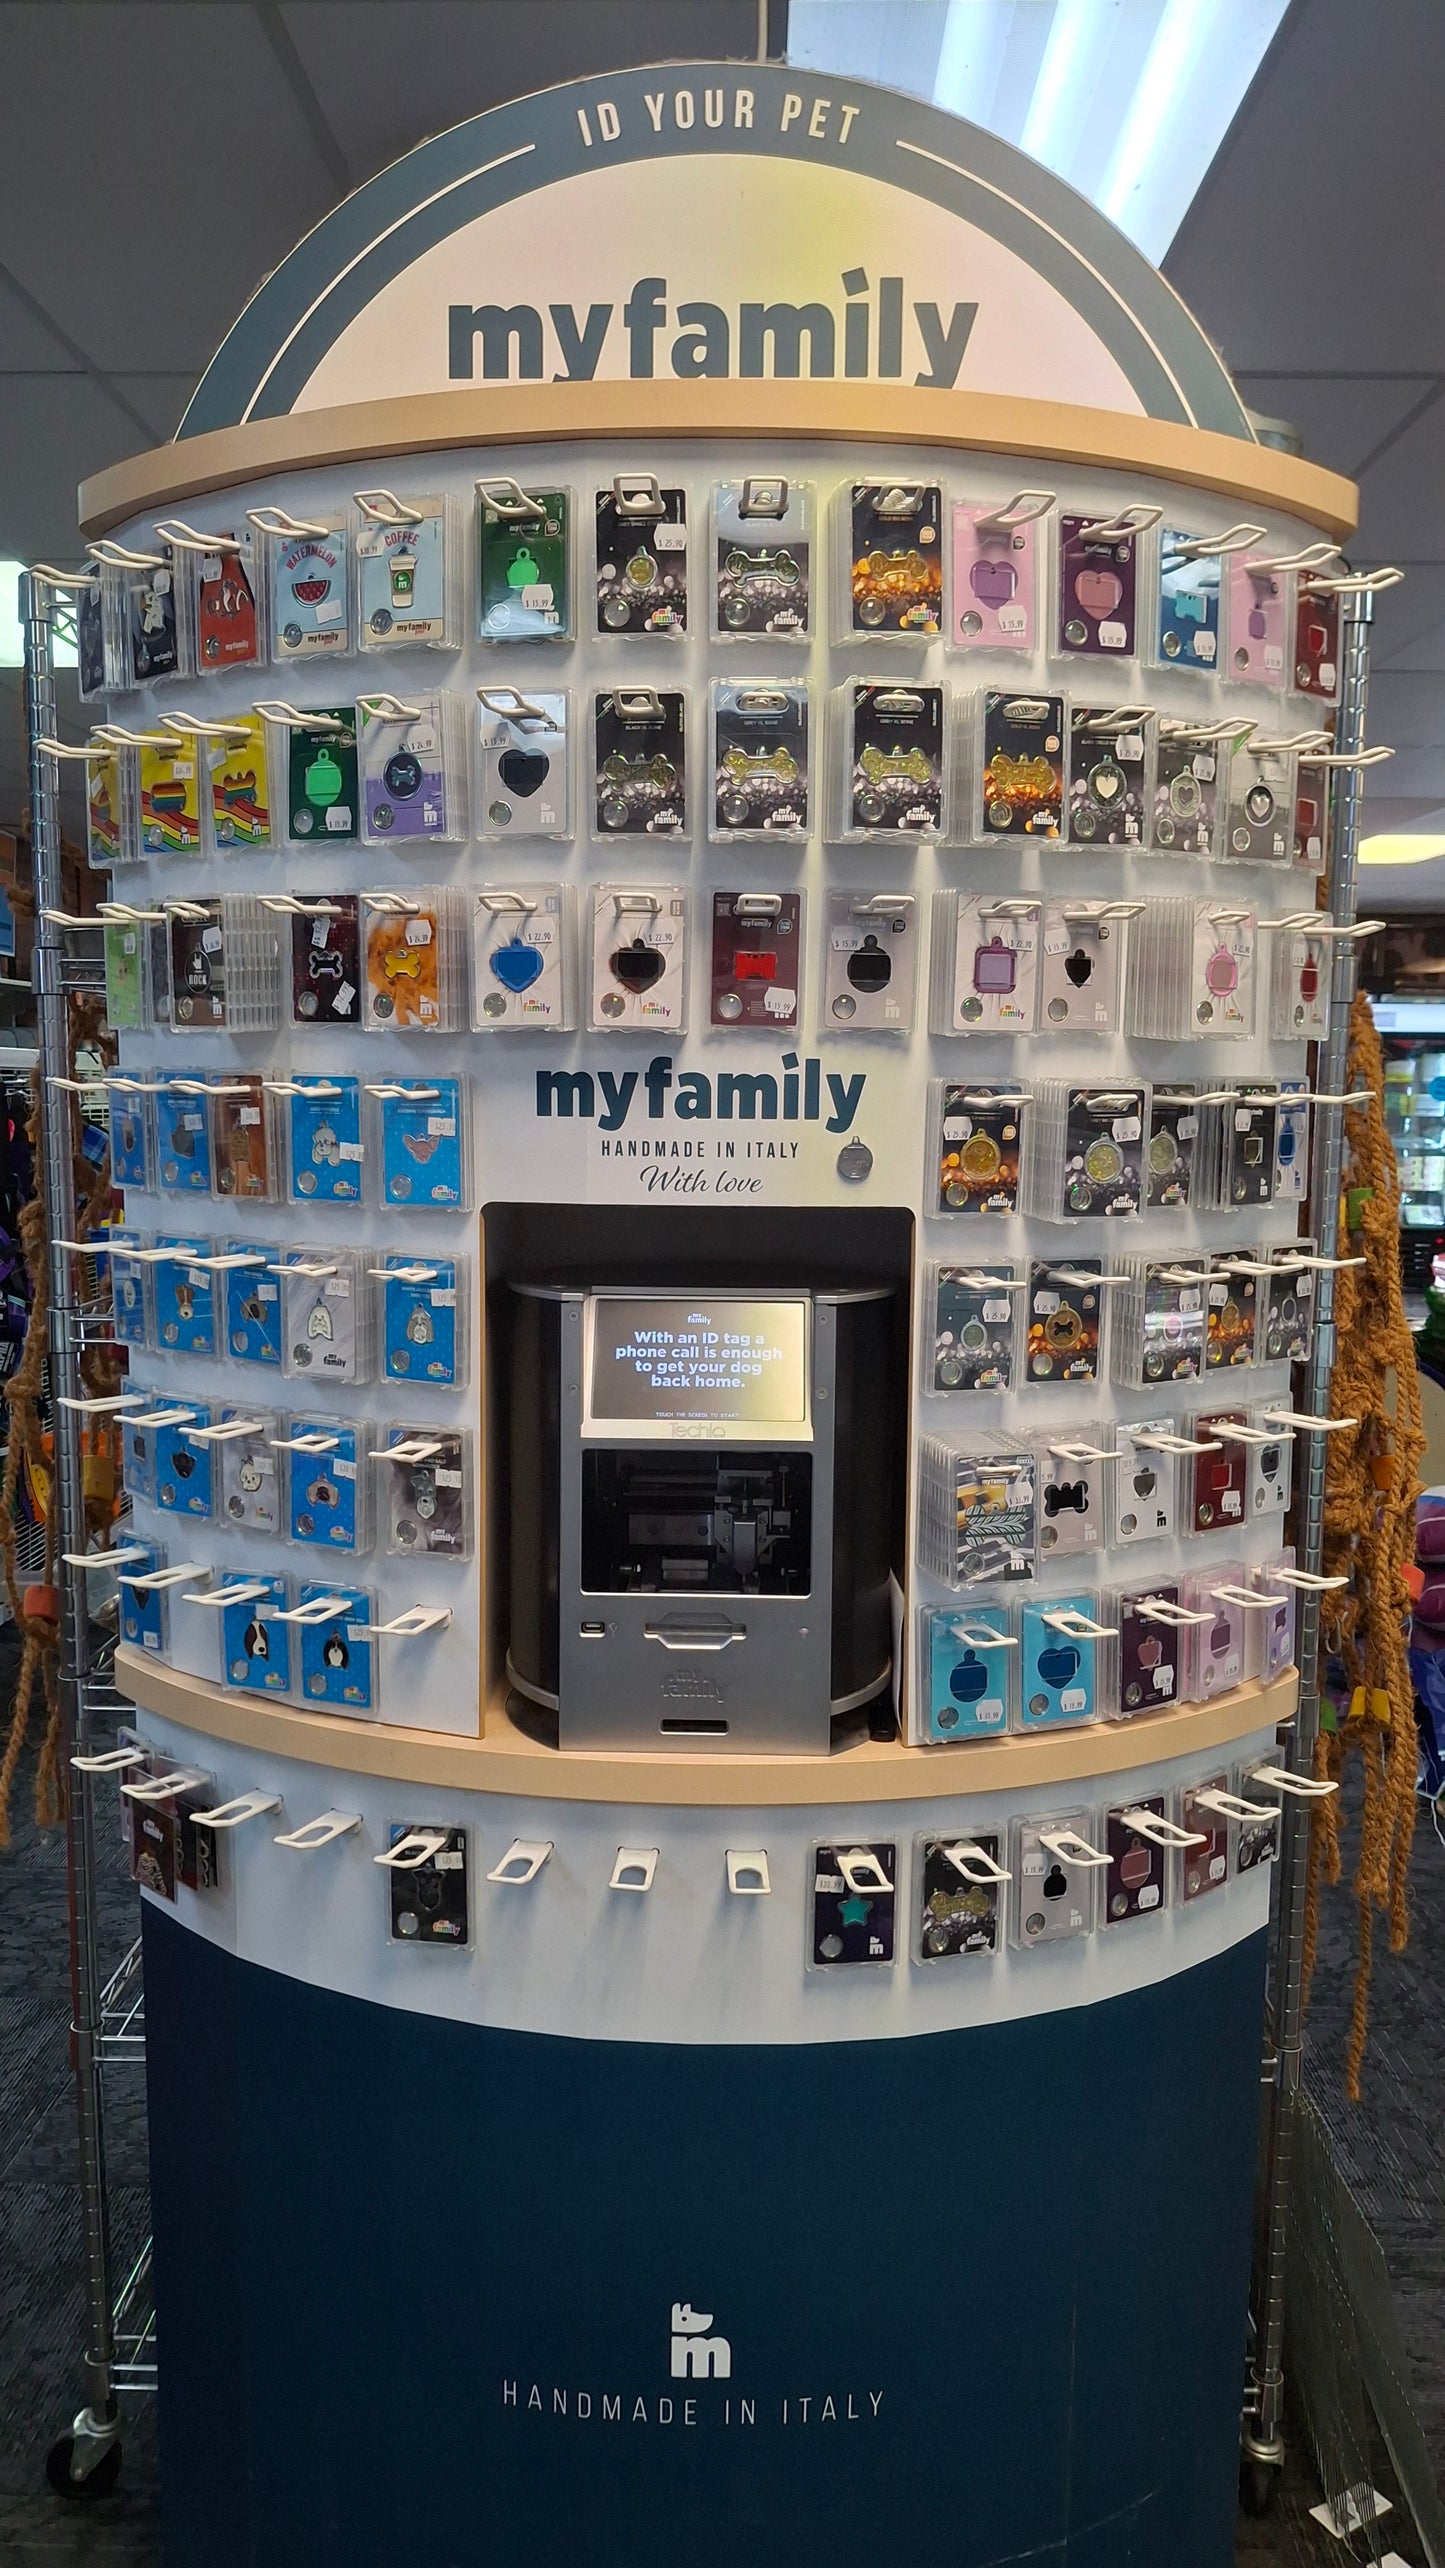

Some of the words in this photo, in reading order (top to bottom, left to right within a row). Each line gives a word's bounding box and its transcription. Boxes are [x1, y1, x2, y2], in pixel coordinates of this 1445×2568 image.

[577, 102, 621, 147] ID
[644, 89, 754, 132] YOUR
[779, 94, 860, 144] PET
[449, 267, 979, 389] myfamily
[384, 531, 420, 548] COFFEE
[285, 544, 338, 571] WATERMELON
[652, 611, 684, 625] family
[773, 613, 805, 627] family
[908, 610, 940, 623] family
[396, 621, 432, 634] myfamily
[307, 632, 339, 645] myfamily
[655, 813, 683, 826] family
[772, 811, 802, 824] family
[906, 810, 936, 823] family
[1032, 815, 1059, 828] family
[188, 974, 207, 985] ROCK
[524, 1002, 551, 1014] family
[643, 1004, 671, 1017] family
[1000, 1007, 1026, 1020] family
[536, 1052, 867, 1134] myfamily
[602, 1140, 705, 1158] HANDMADE
[717, 1141, 735, 1158] IN
[747, 1142, 799, 1159] ITALY
[639, 1165, 710, 1194] With
[715, 1169, 764, 1193] love
[987, 1196, 1014, 1209] family
[1112, 1197, 1138, 1210] family
[687, 1315, 711, 1325] family
[634, 1331, 673, 1344] With
[678, 1334, 697, 1344] an
[703, 1333, 719, 1344] ID
[724, 1333, 750, 1346] tag
[755, 1335, 765, 1345] a
[615, 1345, 667, 1359] phone
[671, 1346, 699, 1358] call
[704, 1346, 717, 1358] is
[721, 1347, 782, 1360] enough
[323, 1356, 346, 1369] family
[635, 1360, 652, 1372] to
[657, 1362, 684, 1374] get
[689, 1363, 726, 1375] your
[730, 1361, 762, 1375] dog
[651, 1374, 690, 1387] back
[695, 1375, 745, 1387] home.
[503, 2379, 697, 2425] HANDMADE
[725, 2399, 755, 2425] IN
[783, 2391, 883, 2425] ITALY
